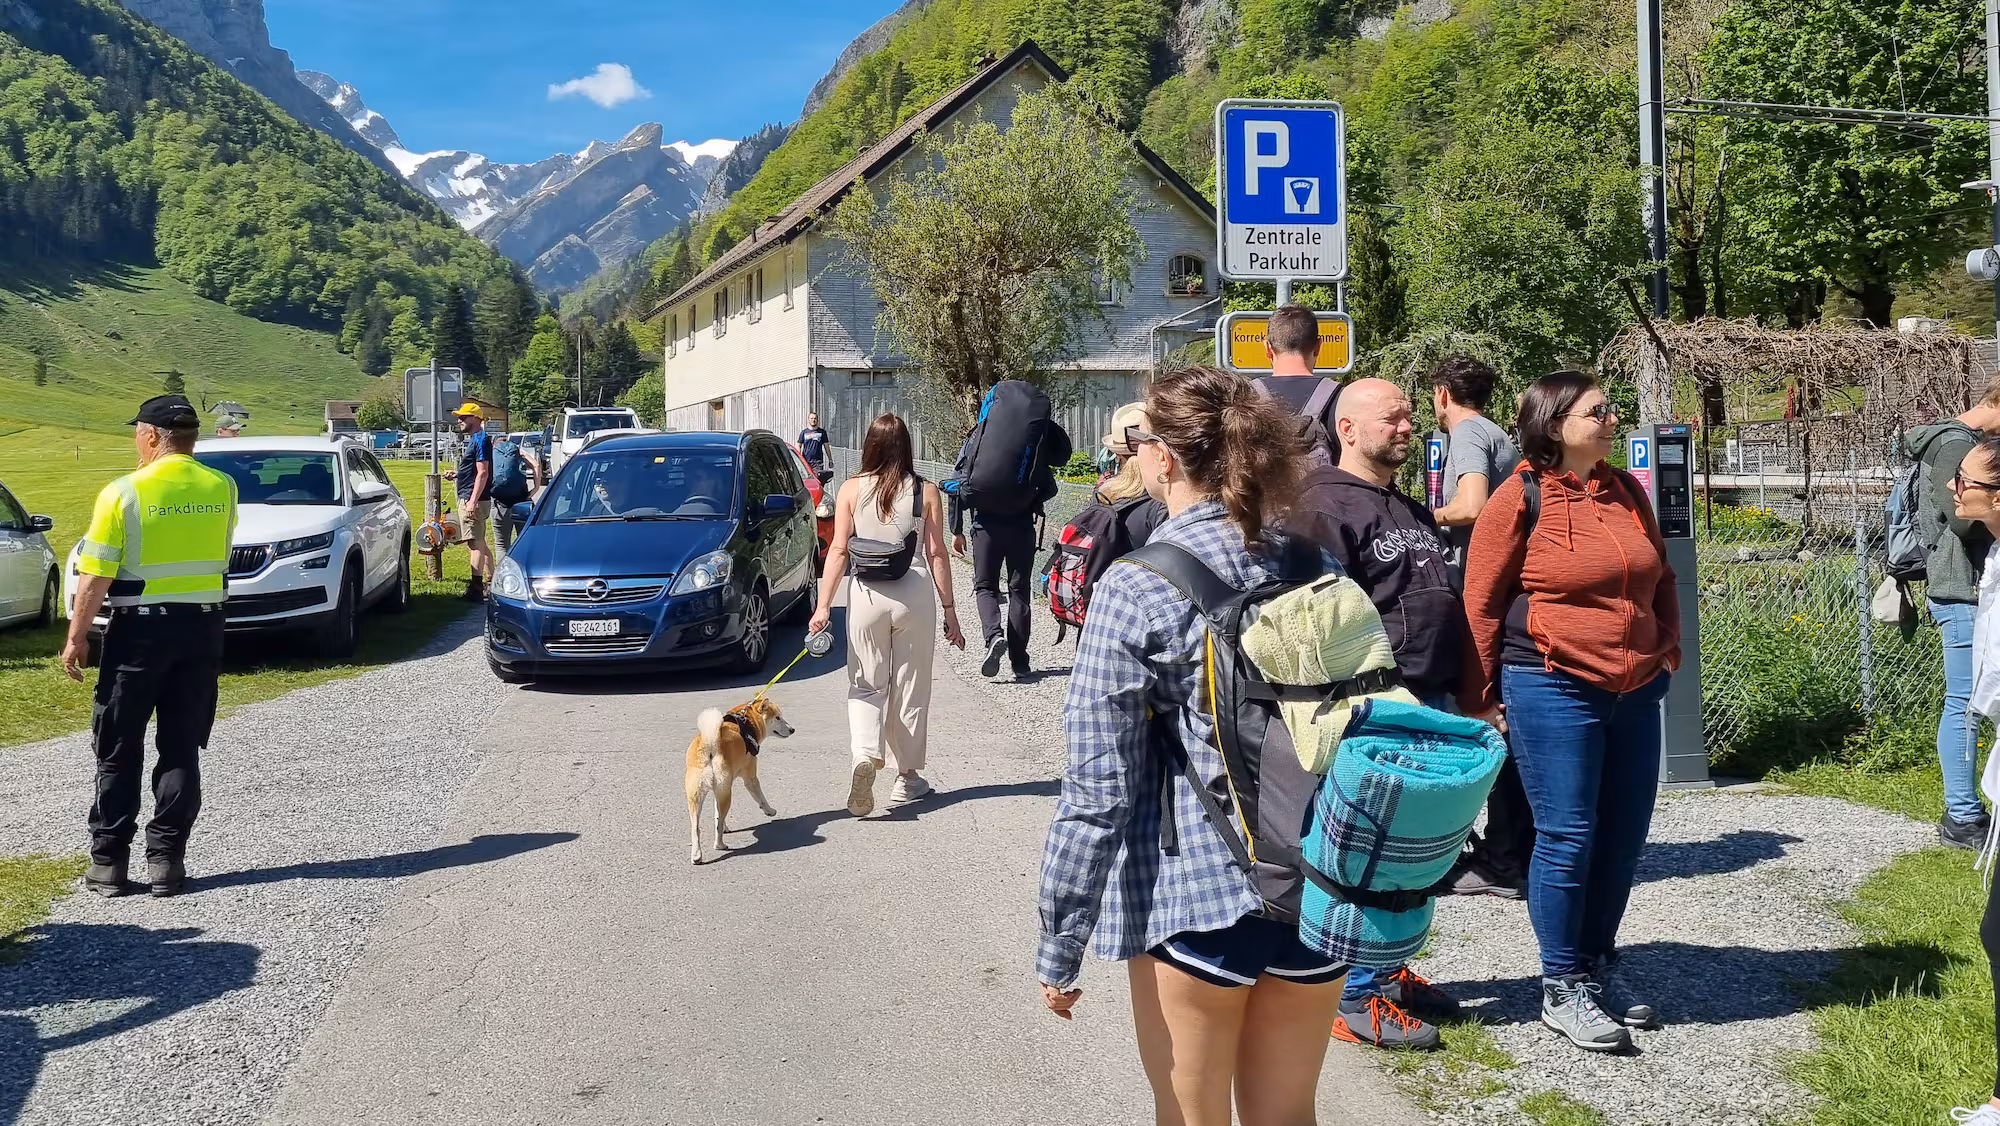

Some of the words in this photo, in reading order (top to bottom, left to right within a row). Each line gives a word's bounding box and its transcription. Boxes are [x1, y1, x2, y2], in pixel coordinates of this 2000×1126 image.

[1244, 120, 1290, 196] P
[1245, 227, 1322, 245] Zentrale
[1250, 251, 1320, 270] Parkuhr
[1234, 331, 1267, 343] korrek
[1430, 445, 1440, 469] P
[1634, 443, 1646, 466] P
[147, 502, 226, 518] Parkdienst
